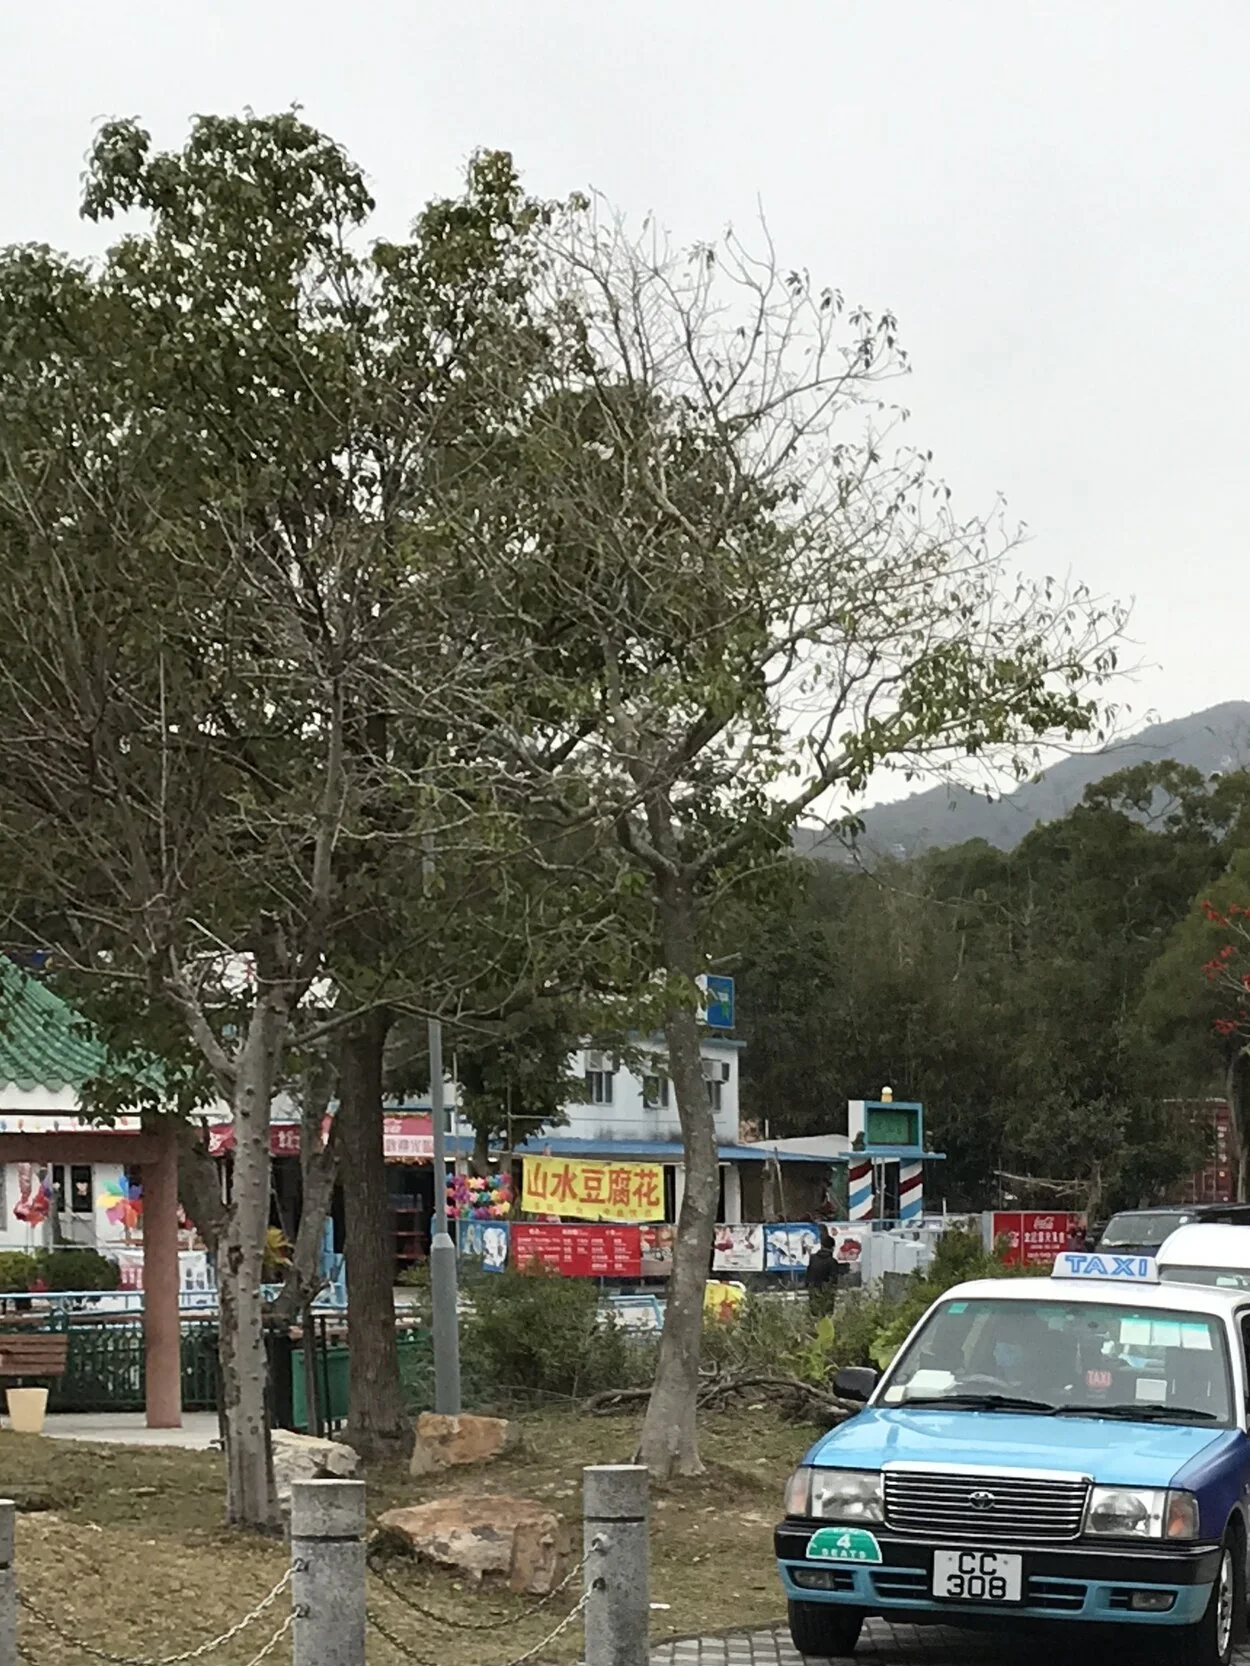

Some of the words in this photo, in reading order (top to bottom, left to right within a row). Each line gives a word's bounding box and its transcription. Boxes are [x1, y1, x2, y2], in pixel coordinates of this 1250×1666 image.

[526, 1162, 660, 1208] 山水豆腐花
[1064, 1255, 1148, 1277] TAXI
[1087, 1370, 1112, 1385] TAXI
[837, 1534, 851, 1549] 4
[821, 1548, 866, 1560] SEATS
[958, 1551, 998, 1576] CC
[946, 1574, 1006, 1600] 308
